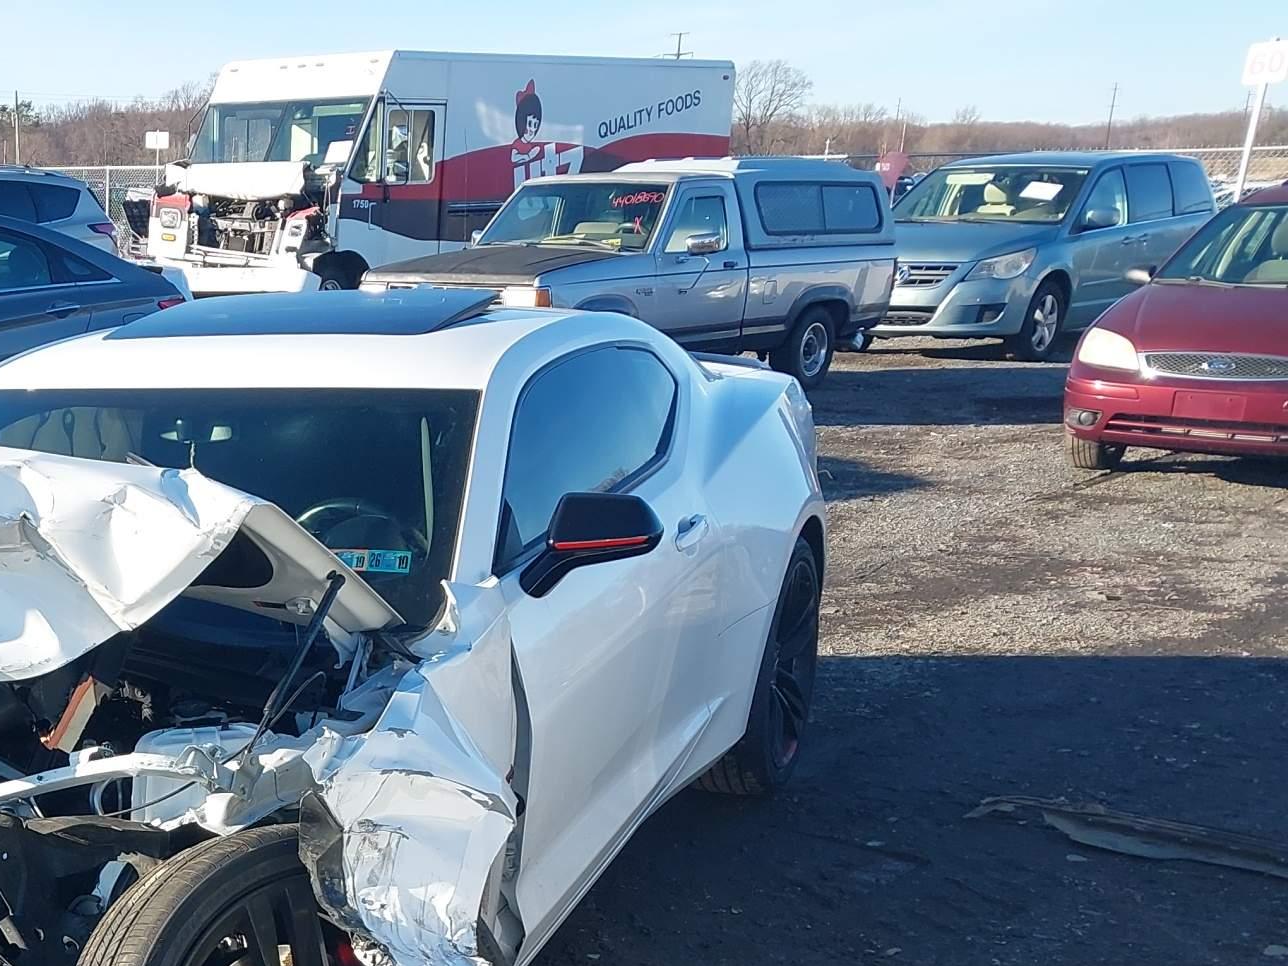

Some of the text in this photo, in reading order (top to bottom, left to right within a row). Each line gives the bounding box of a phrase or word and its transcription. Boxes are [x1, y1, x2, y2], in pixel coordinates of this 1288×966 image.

[598, 90, 701, 138] QUALITY FOODS
[370, 553, 381, 567] 26
